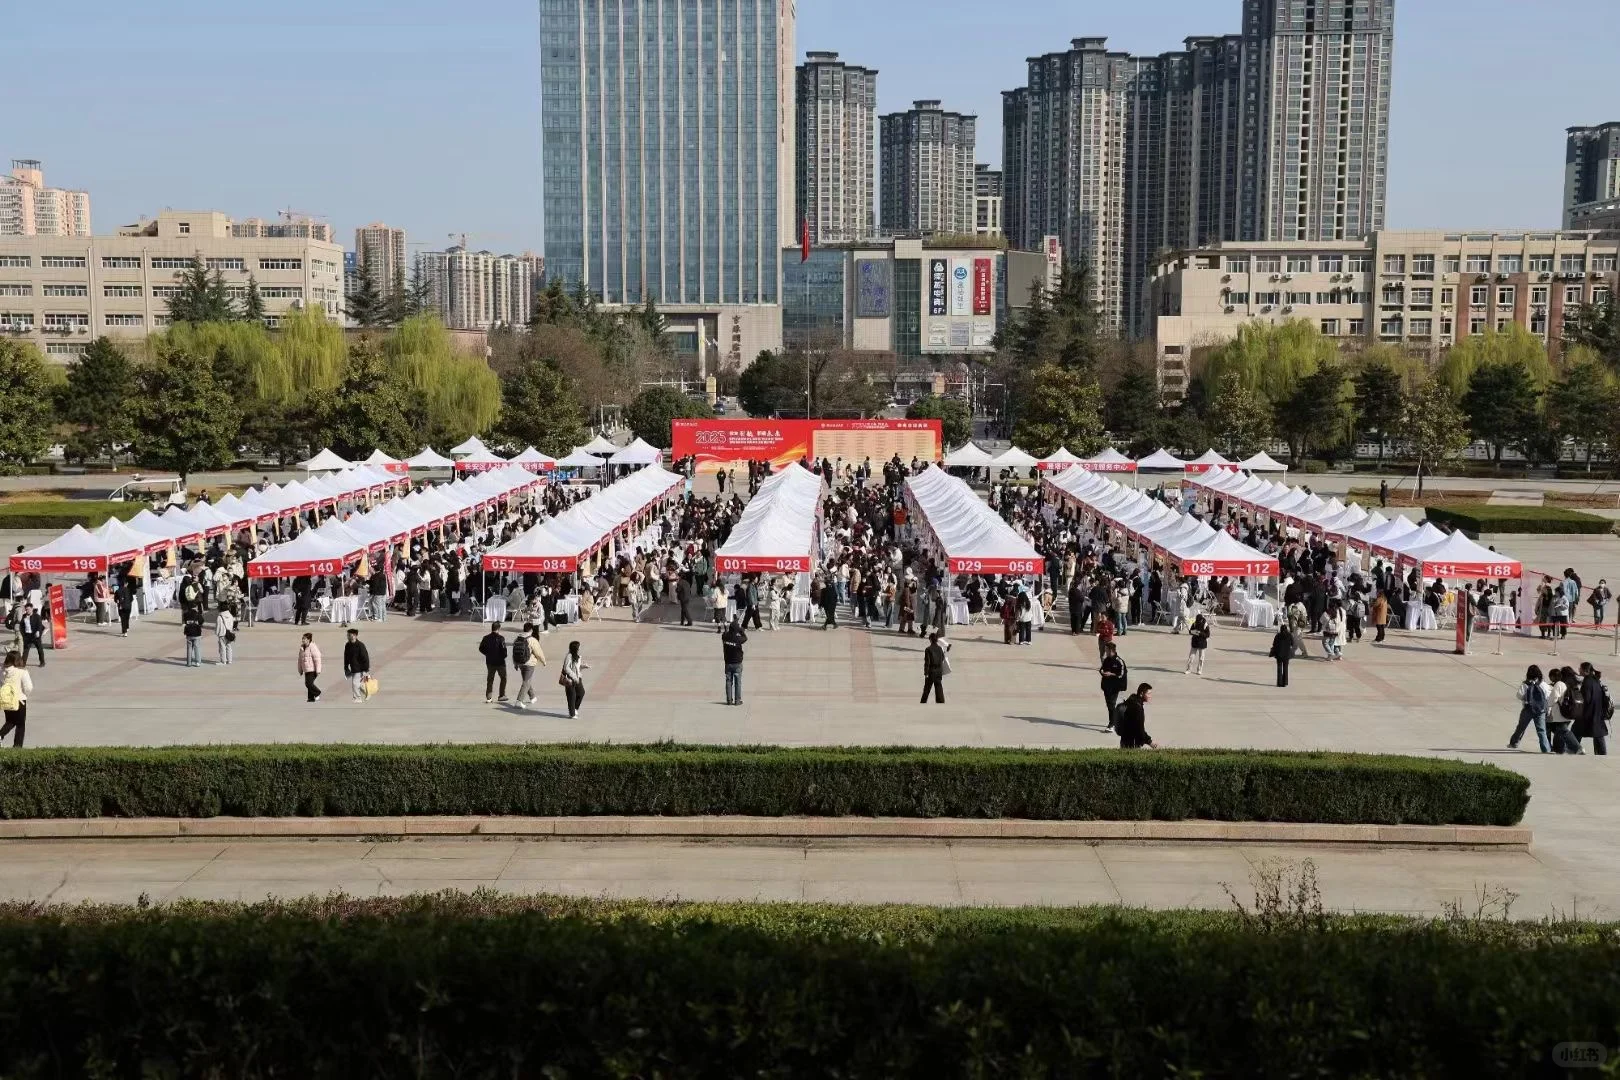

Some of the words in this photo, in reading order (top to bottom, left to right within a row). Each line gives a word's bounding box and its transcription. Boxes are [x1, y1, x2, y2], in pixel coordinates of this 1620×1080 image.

[695, 430, 727, 444] 2025
[464, 462, 545, 470] 长安区人社局咨询处
[1046, 463, 1128, 471] 雁塔区交流服务中心
